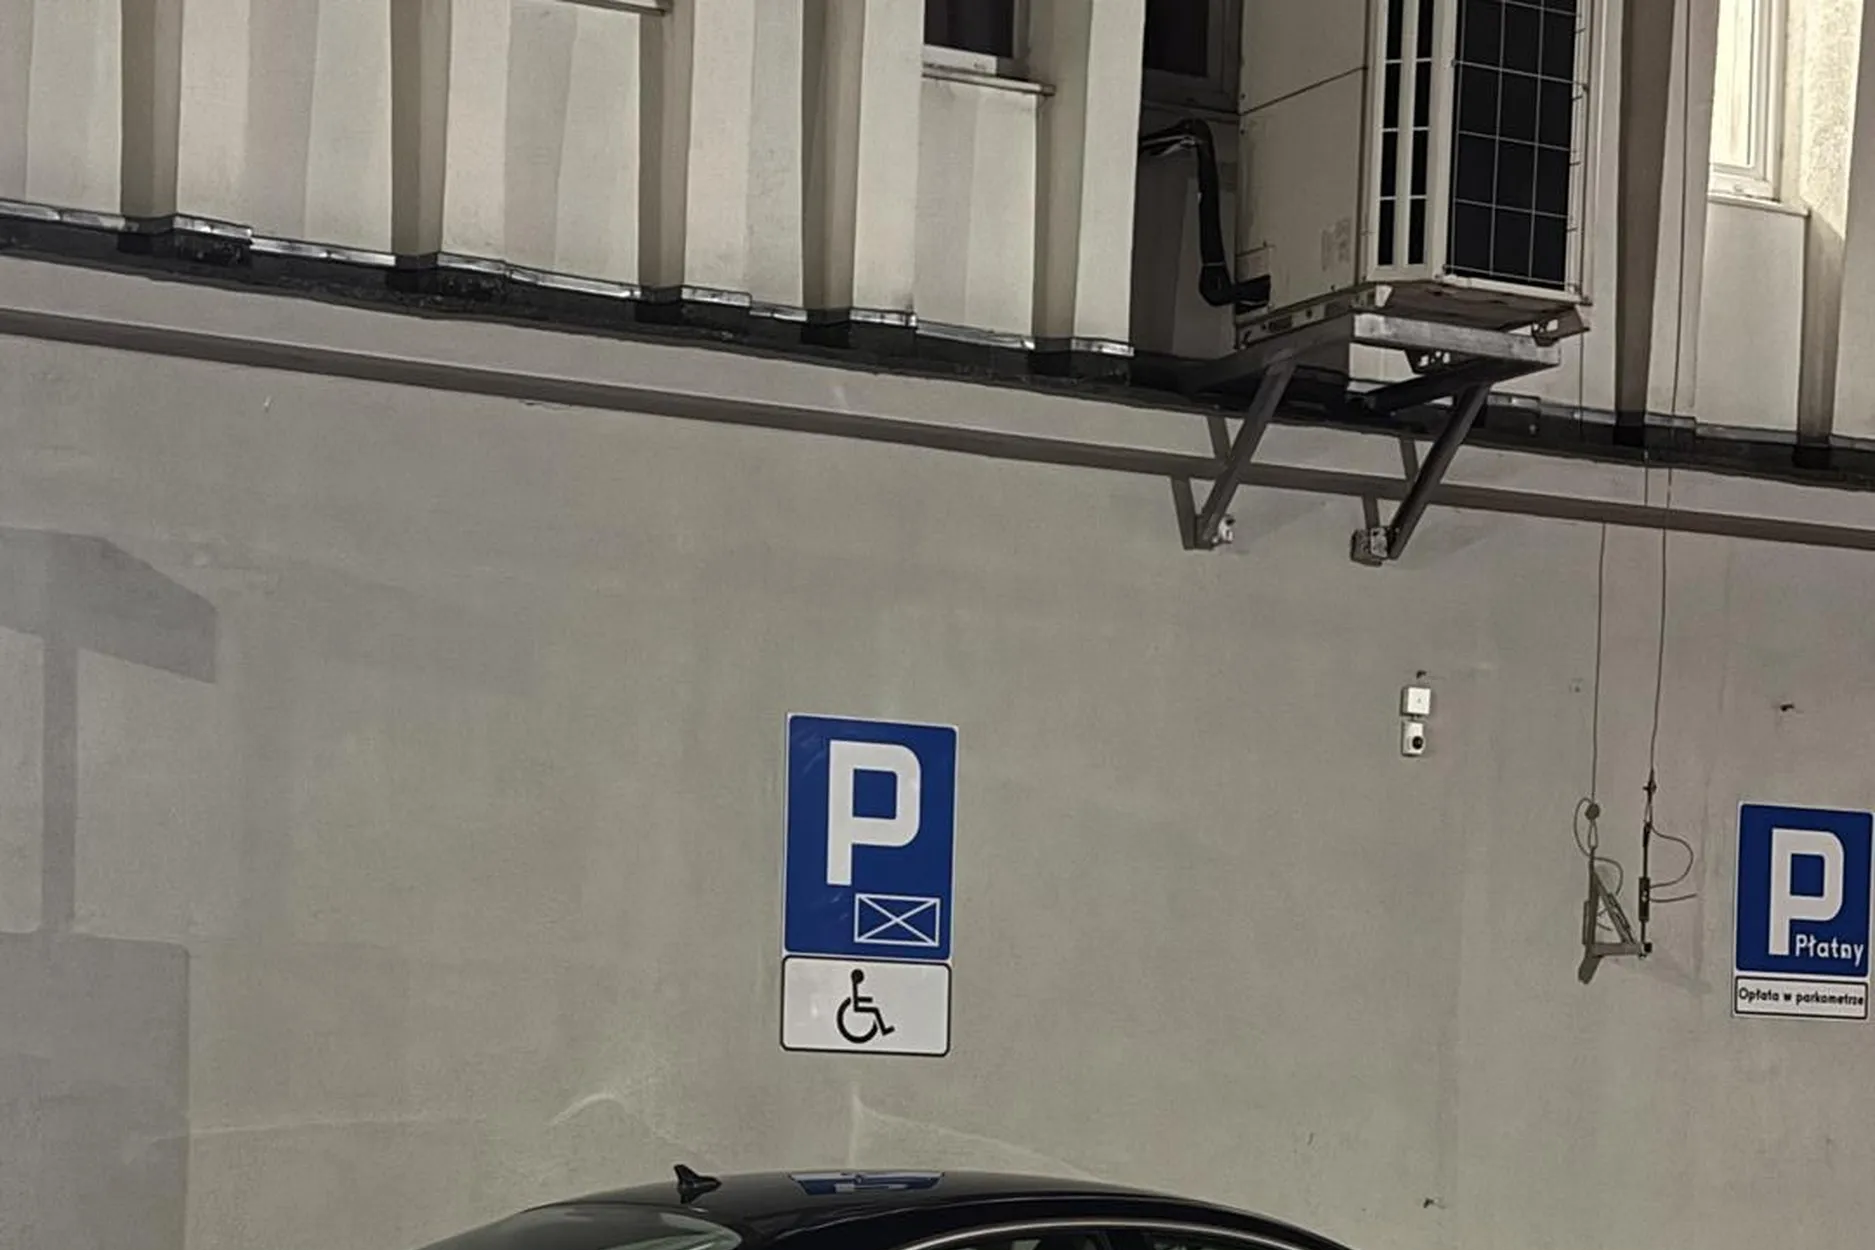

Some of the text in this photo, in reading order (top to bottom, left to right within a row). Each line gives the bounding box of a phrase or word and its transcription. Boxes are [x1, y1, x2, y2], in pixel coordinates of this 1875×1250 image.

[826, 739, 922, 886] P
[1768, 827, 1845, 956] P
[1795, 934, 1864, 968] Płatny
[1738, 987, 1864, 1006] Opłata w parkometrze
